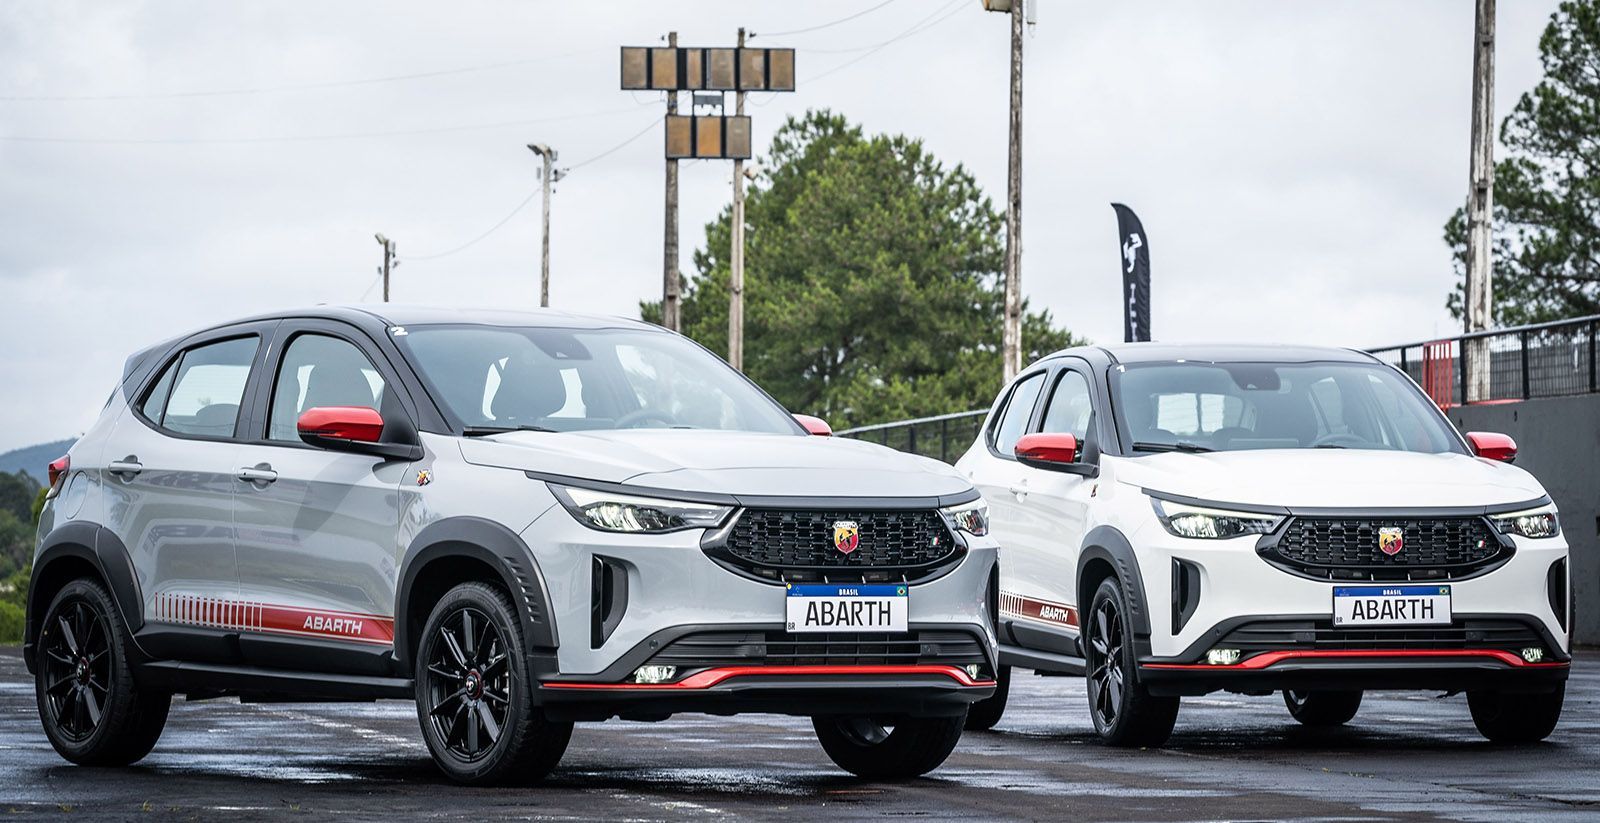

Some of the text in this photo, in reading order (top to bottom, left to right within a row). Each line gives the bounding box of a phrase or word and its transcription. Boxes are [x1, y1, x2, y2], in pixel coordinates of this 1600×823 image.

[390, 326, 409, 336] 2
[838, 588, 859, 596] BRASIL
[805, 601, 891, 626] ABARTH
[1039, 605, 1069, 622] ABARTH
[1351, 598, 1434, 621] ABARTH
[303, 615, 363, 635] ABARTH
[787, 621, 796, 631] BR
